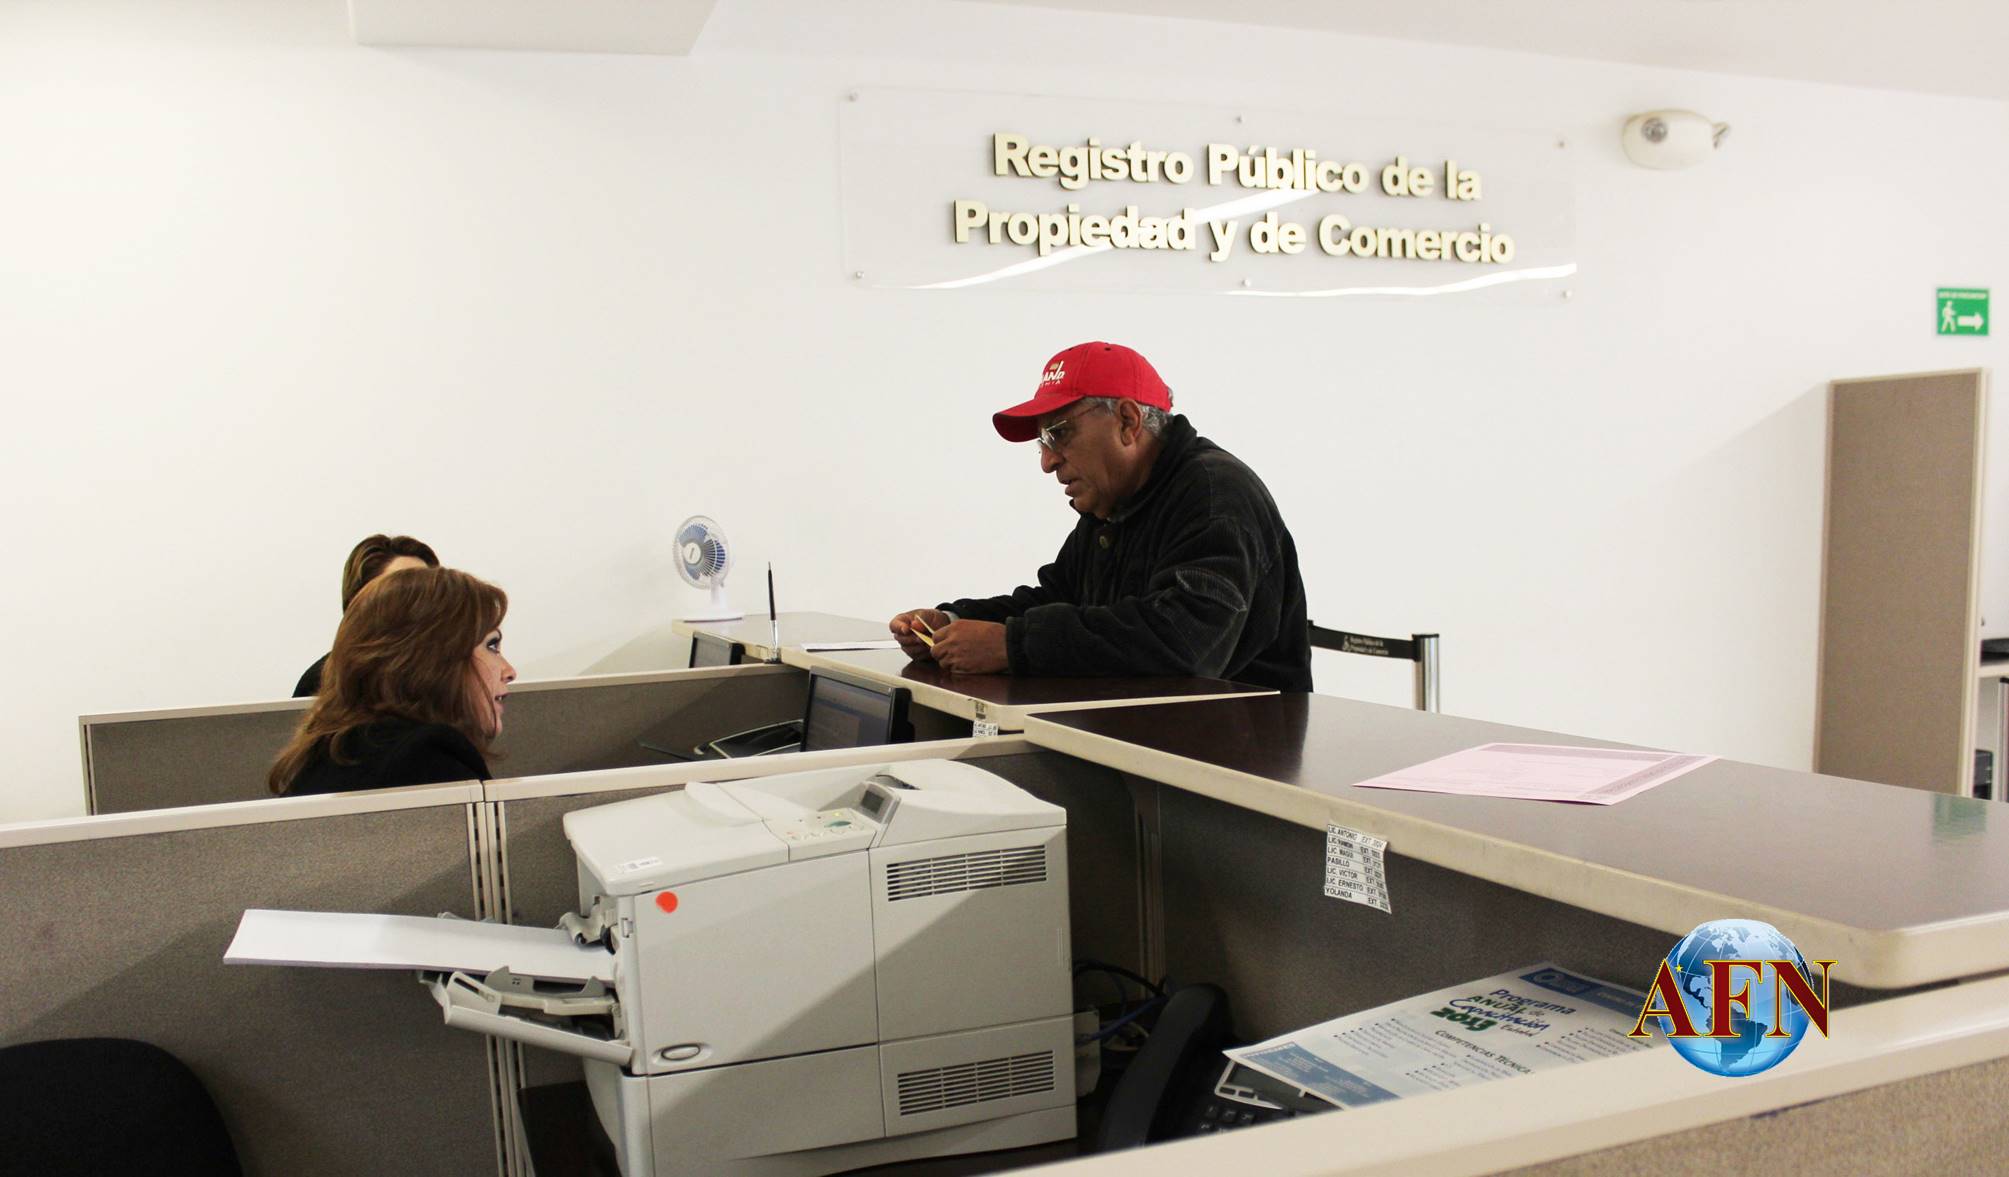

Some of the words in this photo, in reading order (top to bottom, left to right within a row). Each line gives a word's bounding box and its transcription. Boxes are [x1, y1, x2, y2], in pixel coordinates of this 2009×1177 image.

[993, 131, 1194, 190] Registro
[1207, 143, 1370, 194] Público
[1381, 155, 1435, 197] de
[1443, 159, 1482, 201] la
[954, 199, 1196, 256] Propiedad
[1207, 218, 1239, 263] y
[1249, 211, 1307, 255] de
[1318, 213, 1515, 264] Comercio
[1339, 869, 1358, 879] VICTOR
[1326, 887, 1353, 899] YOLANDA
[1338, 879, 1364, 892] ERNESTO
[1468, 996, 1527, 1015] ANUAL
[1489, 988, 1576, 1015] Programa
[1430, 1006, 1498, 1031] 2013
